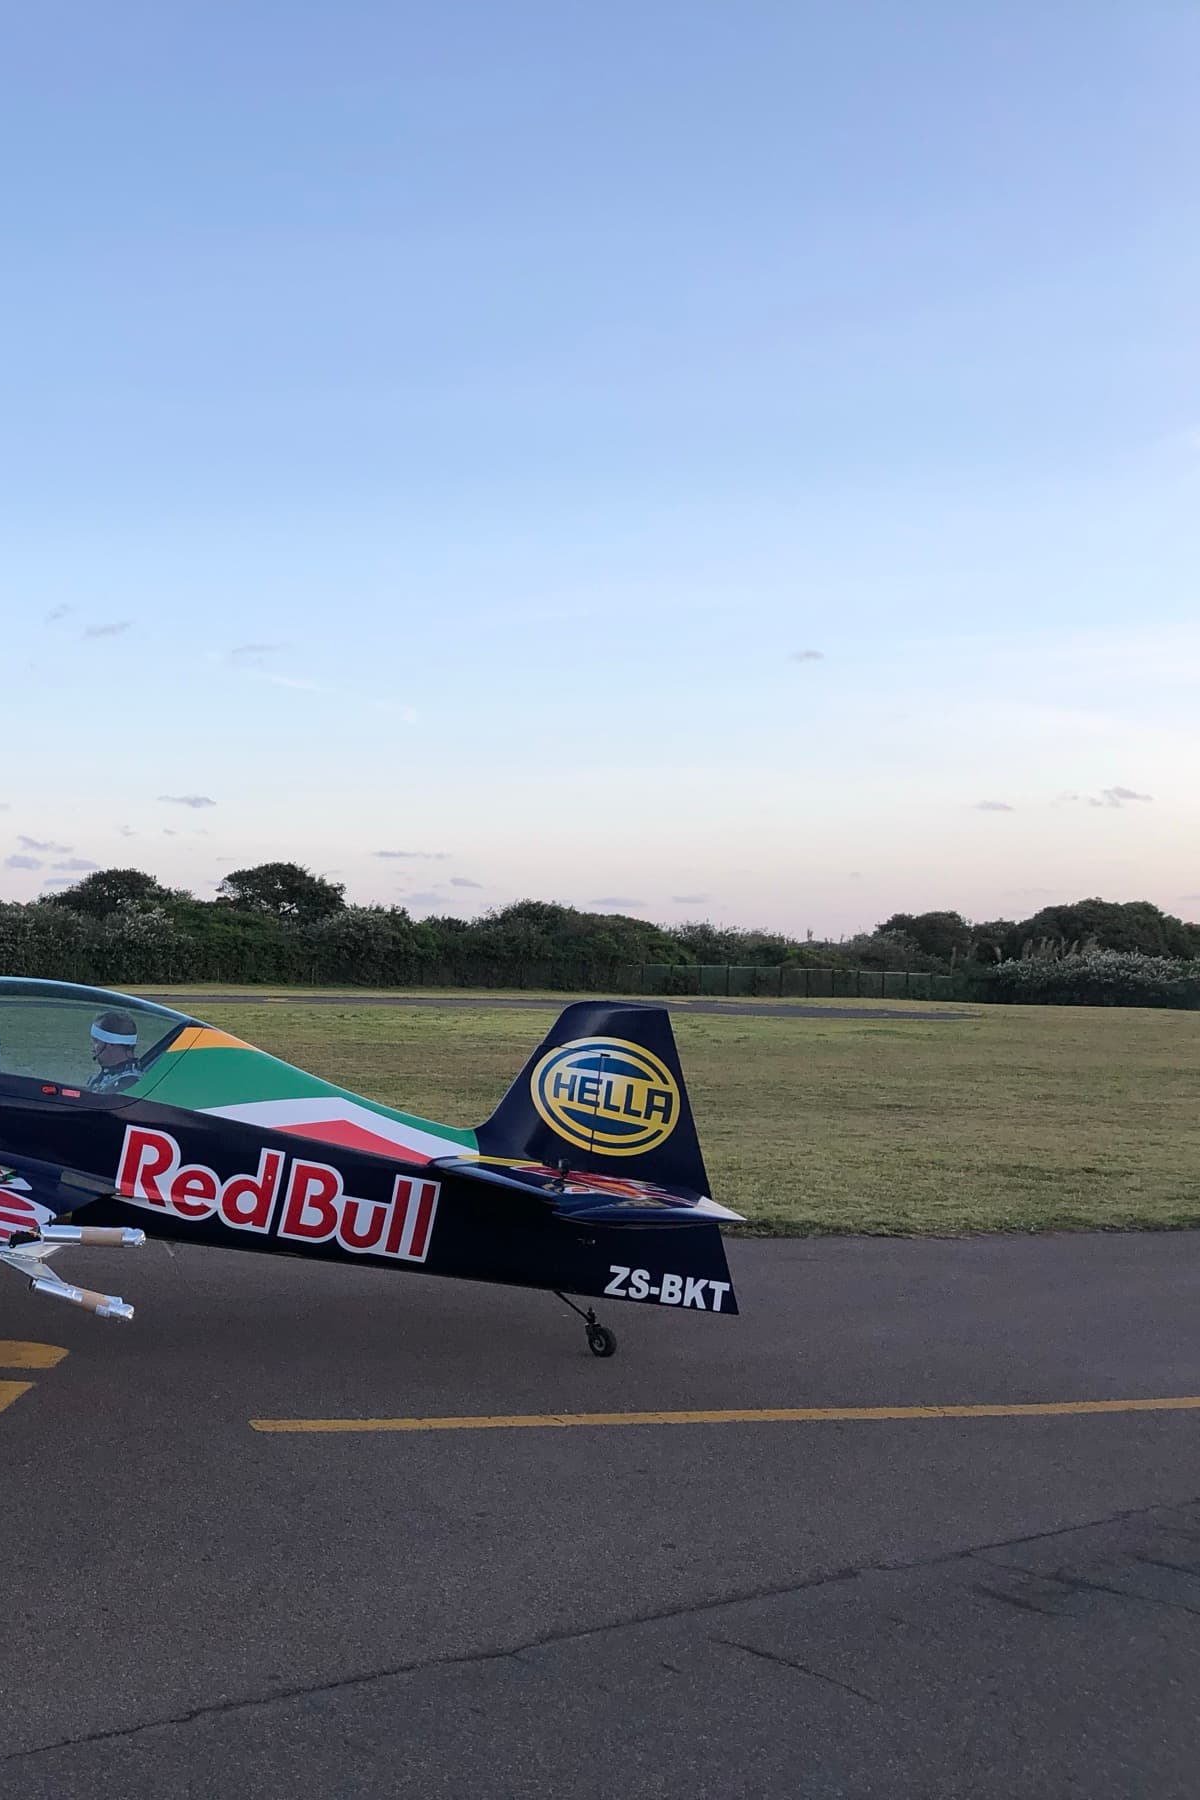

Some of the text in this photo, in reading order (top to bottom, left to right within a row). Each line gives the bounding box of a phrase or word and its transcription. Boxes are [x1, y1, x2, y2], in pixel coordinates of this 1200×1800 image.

[553, 1072, 673, 1124] HELLA
[116, 1125, 441, 1263] Red Bull
[604, 1265, 730, 1312] ZS-BKT
